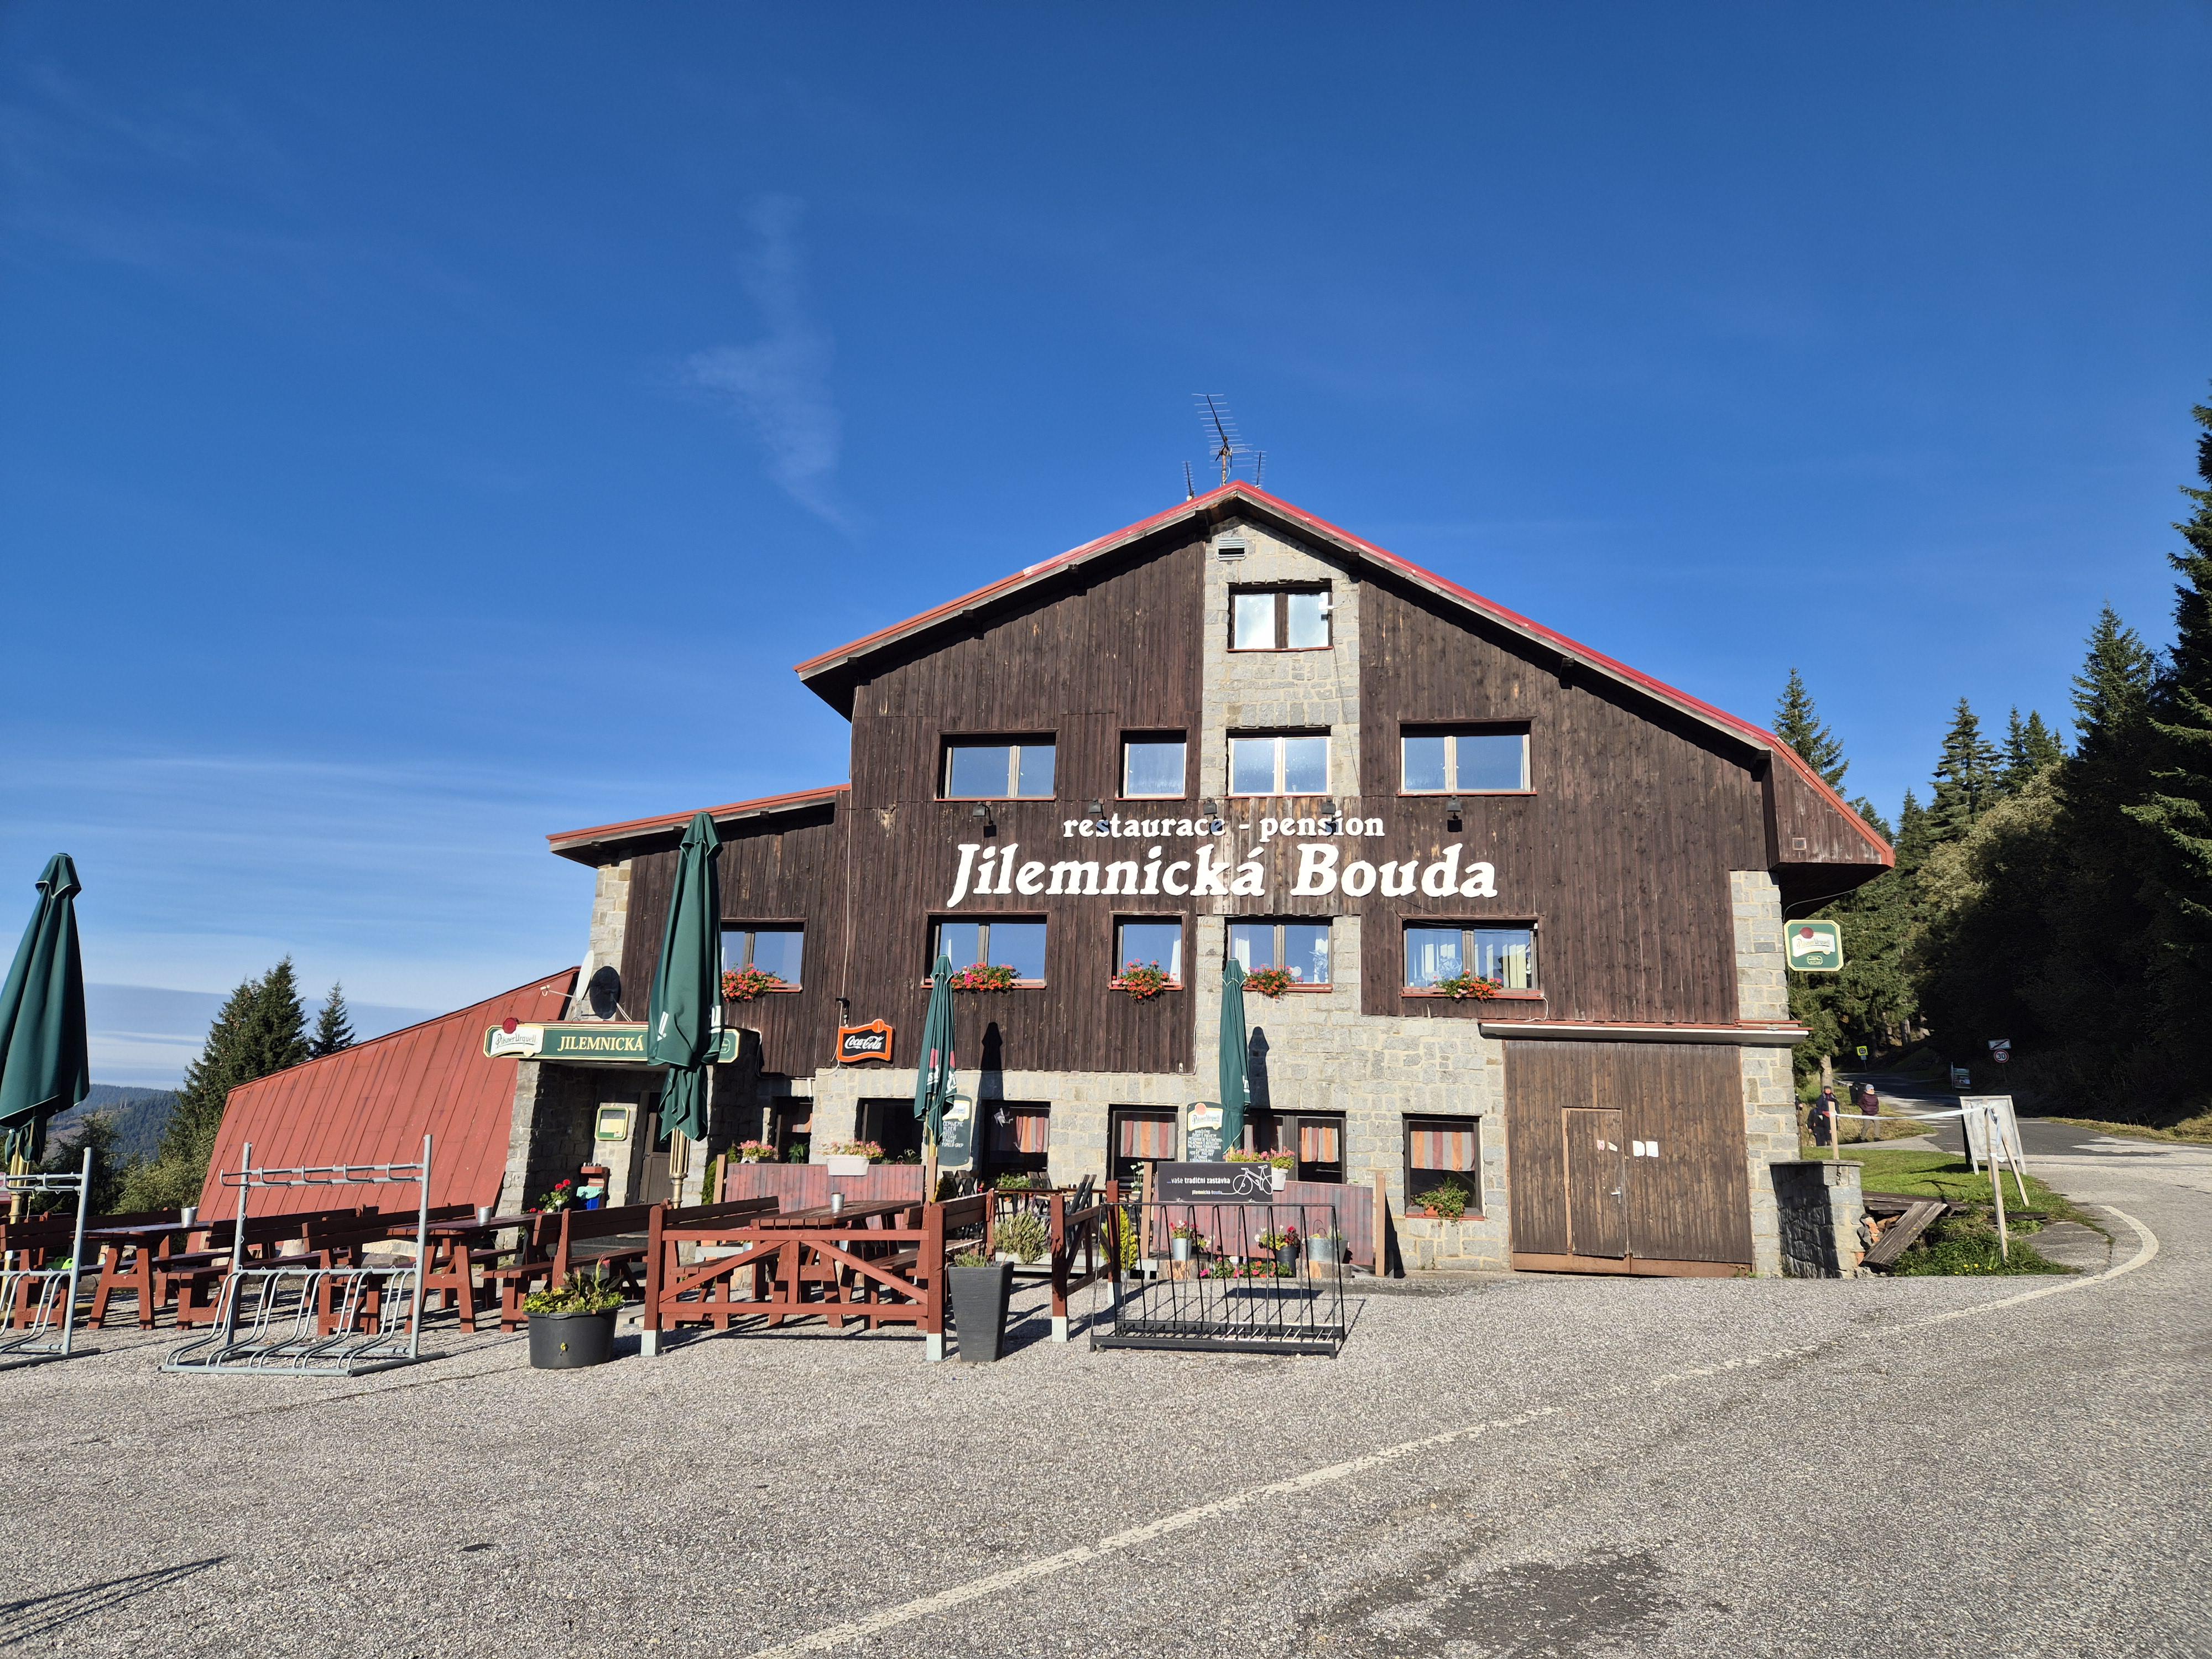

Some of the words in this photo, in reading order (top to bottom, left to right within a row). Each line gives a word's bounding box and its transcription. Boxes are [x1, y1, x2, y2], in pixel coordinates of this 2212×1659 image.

[1063, 813, 1225, 838] restaurace
[1259, 810, 1385, 843] pension
[947, 843, 1265, 907] Jilemnická
[1290, 843, 1498, 898] Bouda
[495, 1034, 515, 1048] Pilsner
[515, 1033, 536, 1046] Urquell
[557, 1035, 644, 1052] JILEMNICKÁ
[844, 1035, 885, 1050] Coca-Cola
